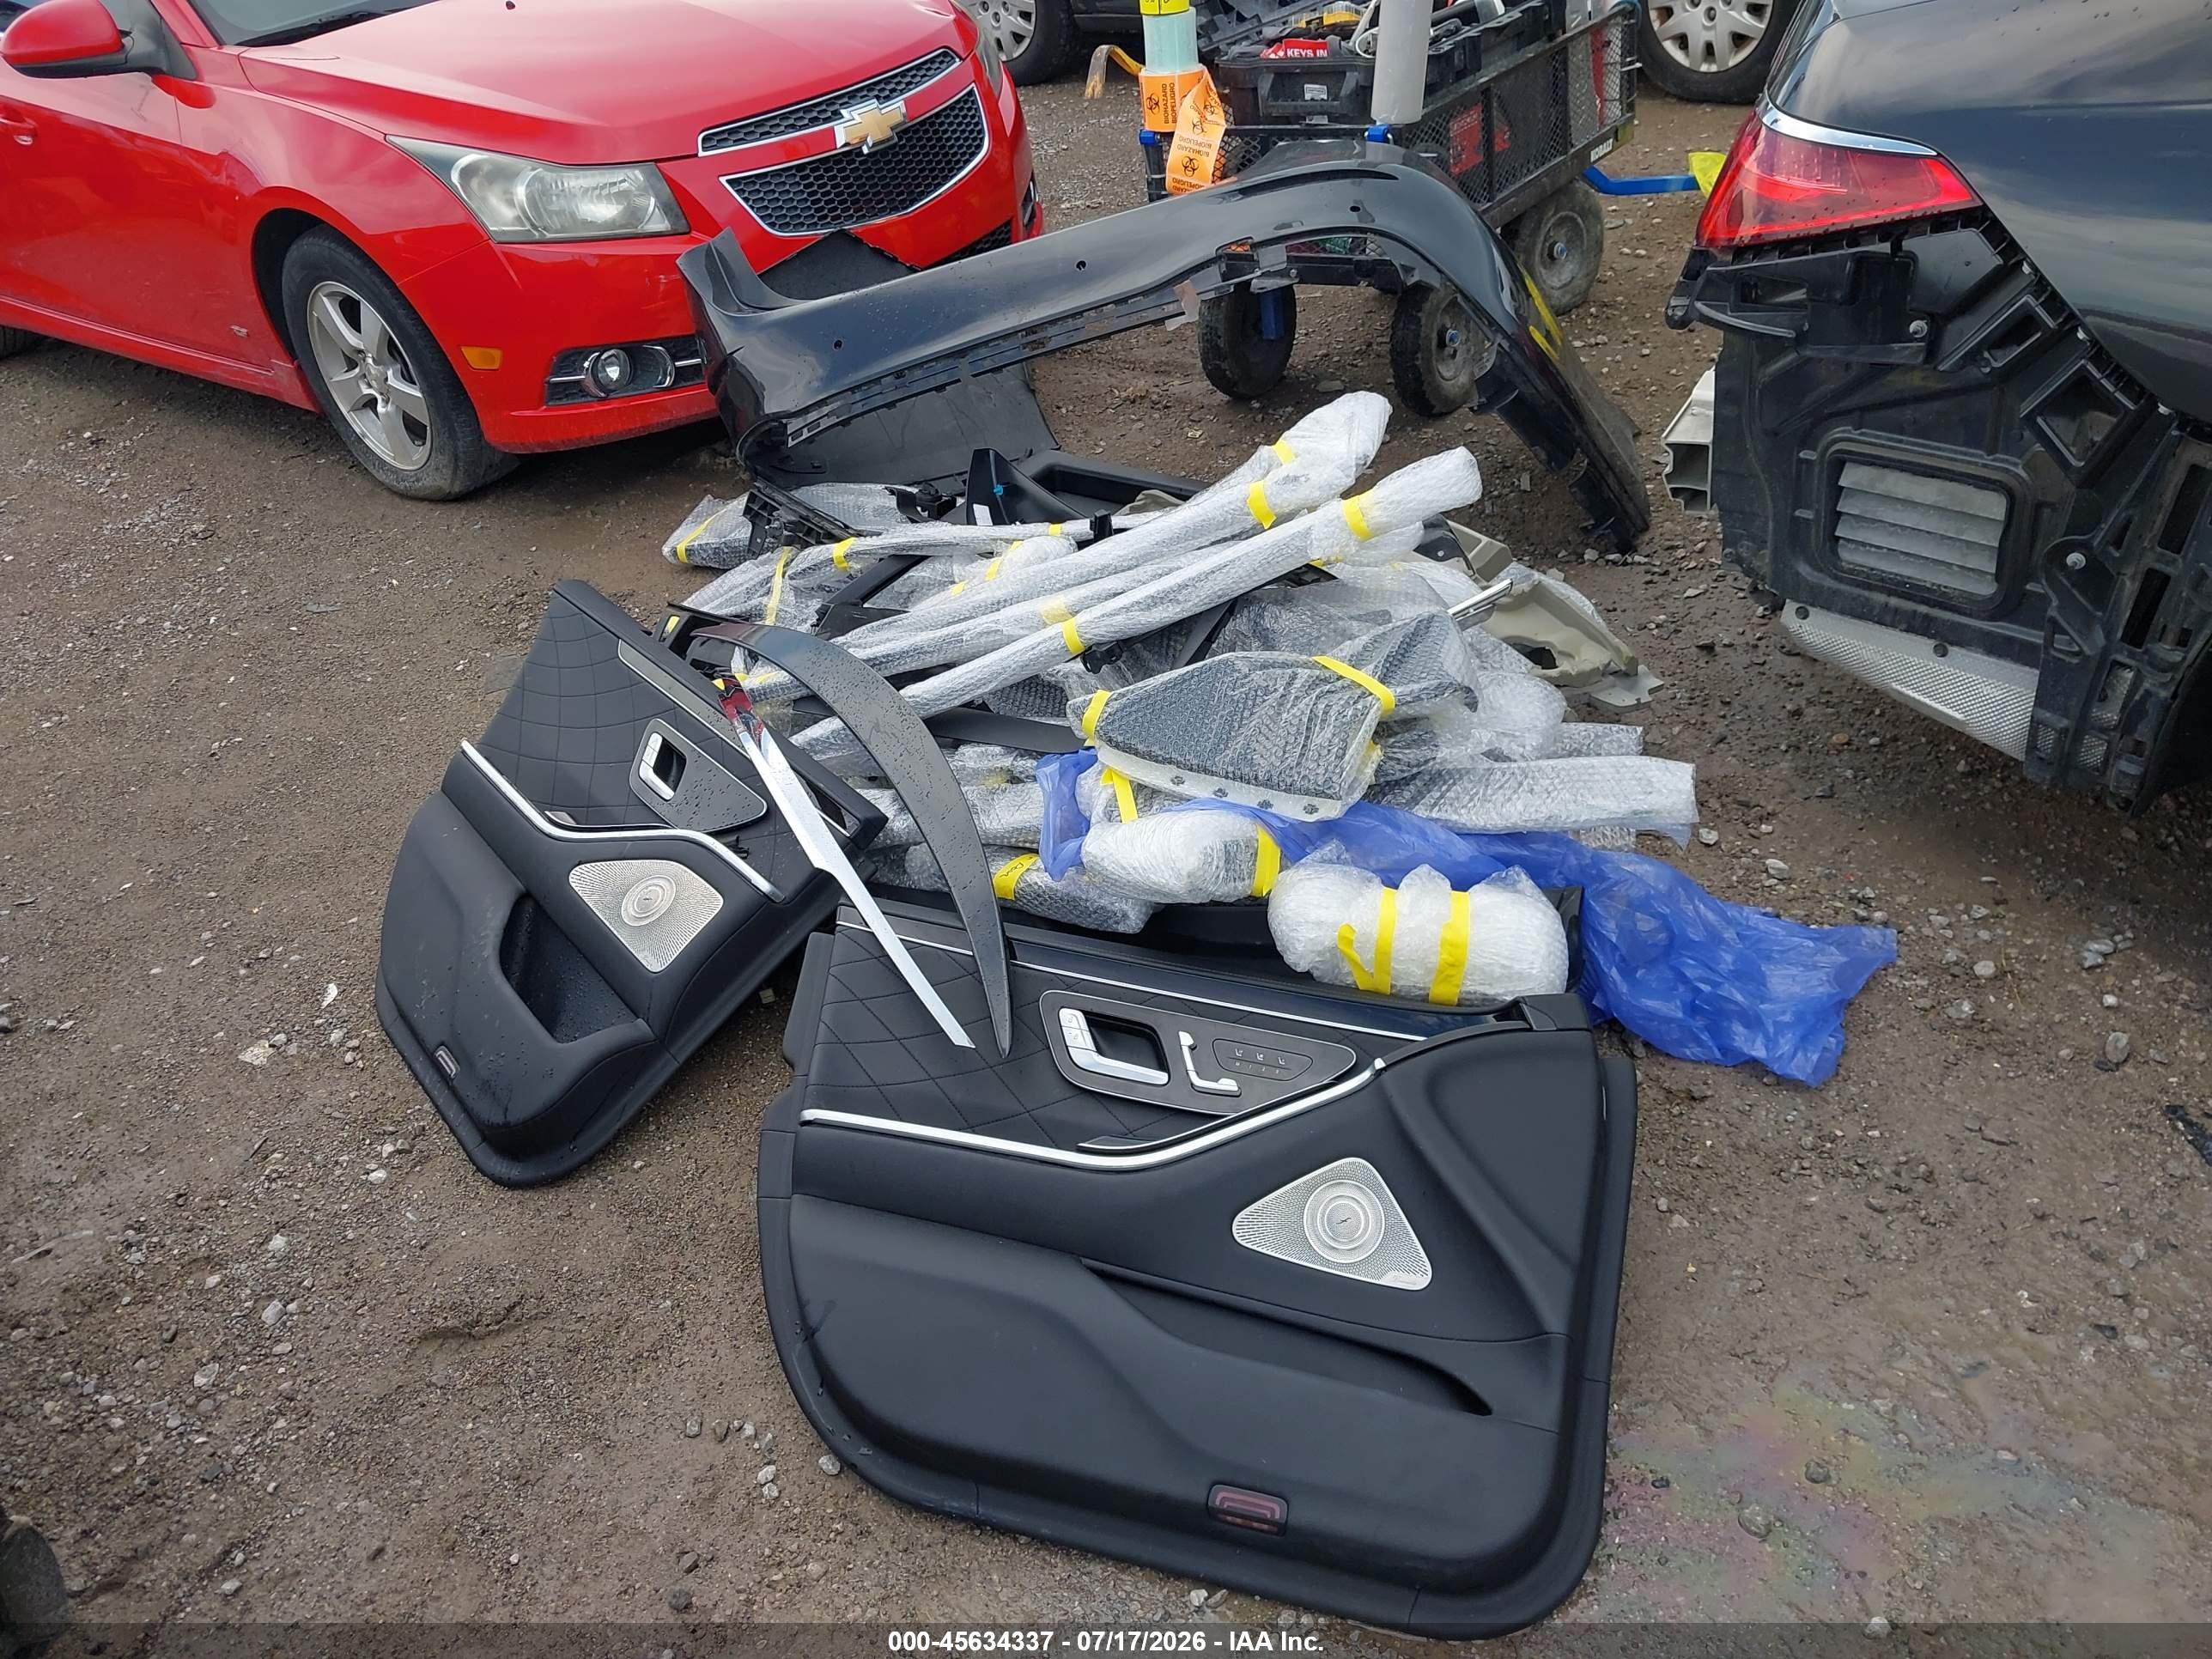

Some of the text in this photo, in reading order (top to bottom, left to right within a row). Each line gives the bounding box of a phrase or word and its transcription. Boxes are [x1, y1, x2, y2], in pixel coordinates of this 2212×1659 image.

[1286, 48, 1328, 58] KEYS IN
[1169, 82, 1177, 124] BIOPELIGRO
[1176, 143, 1210, 158] BIOHAZARD
[1171, 177, 1205, 190] IOPELIGRO
